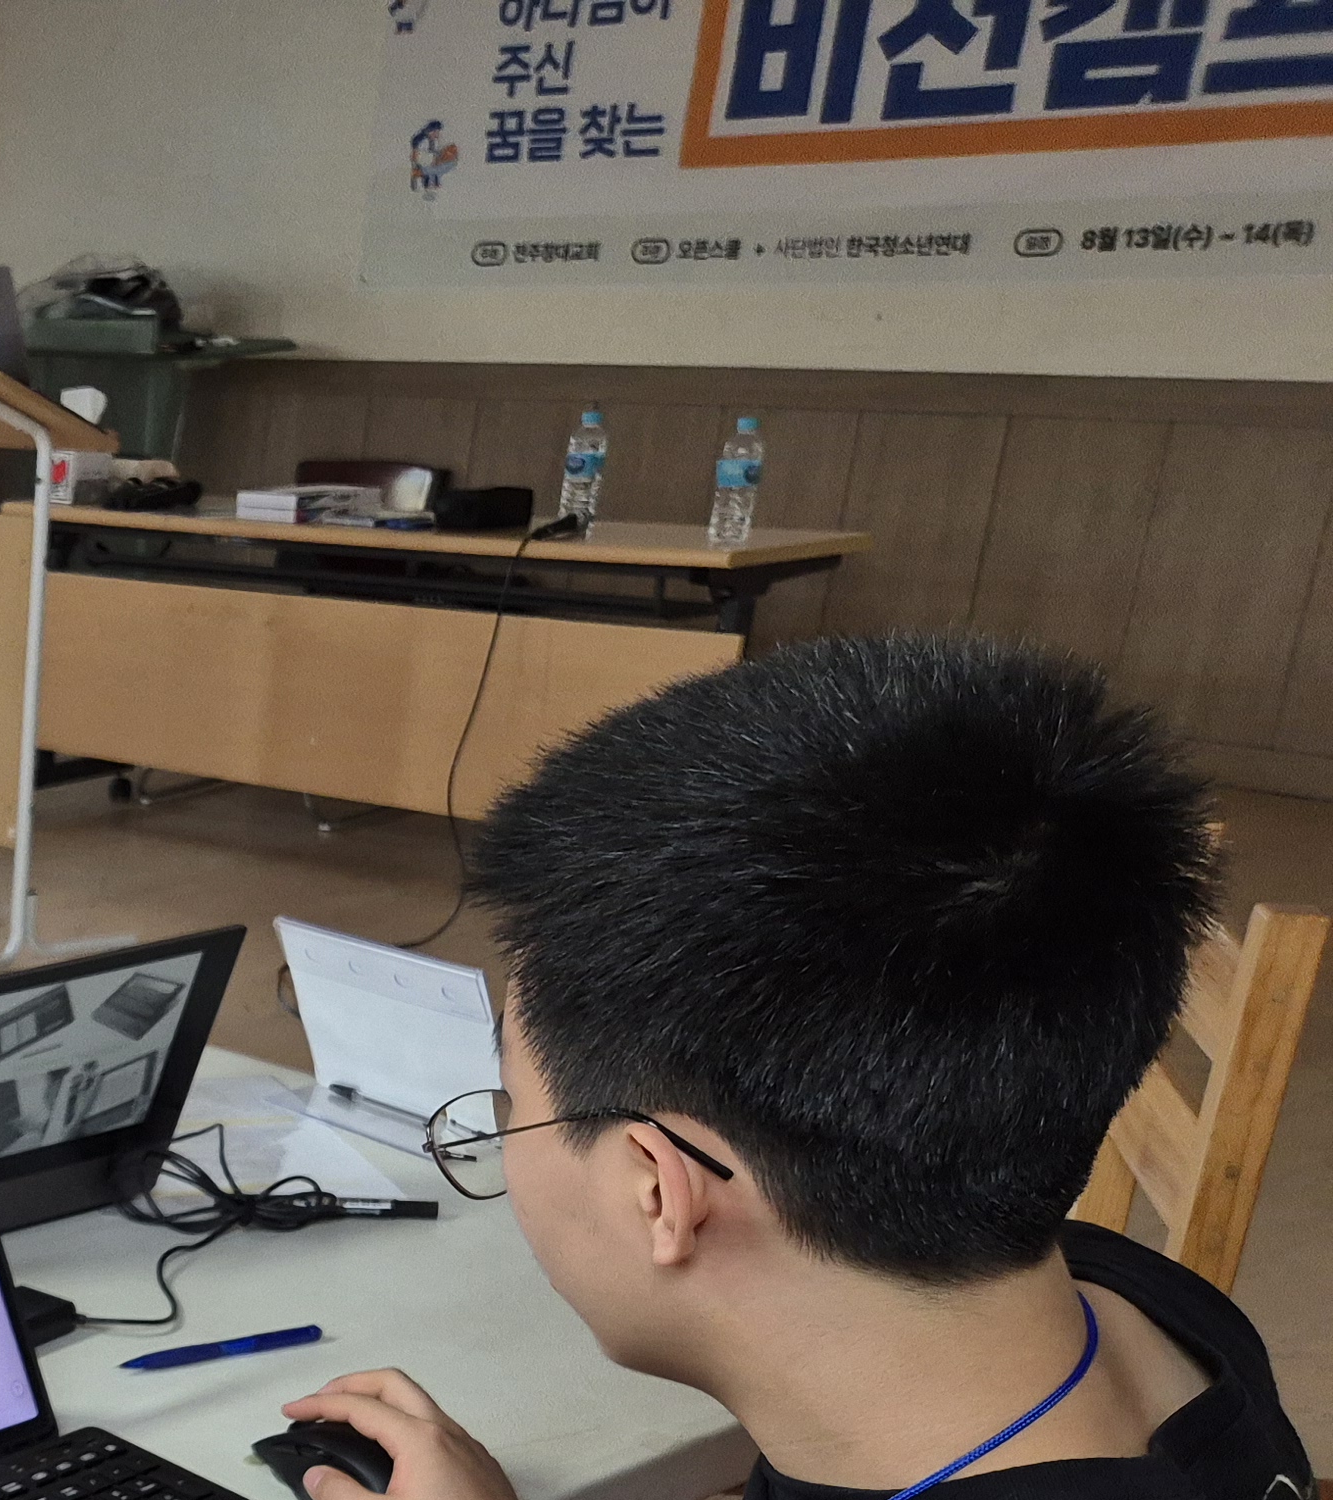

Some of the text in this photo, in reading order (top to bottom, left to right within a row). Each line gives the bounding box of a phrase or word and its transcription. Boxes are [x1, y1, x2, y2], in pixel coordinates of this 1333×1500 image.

[492, 40, 575, 98] 주신
[485, 102, 665, 163] 꿈을 찾는
